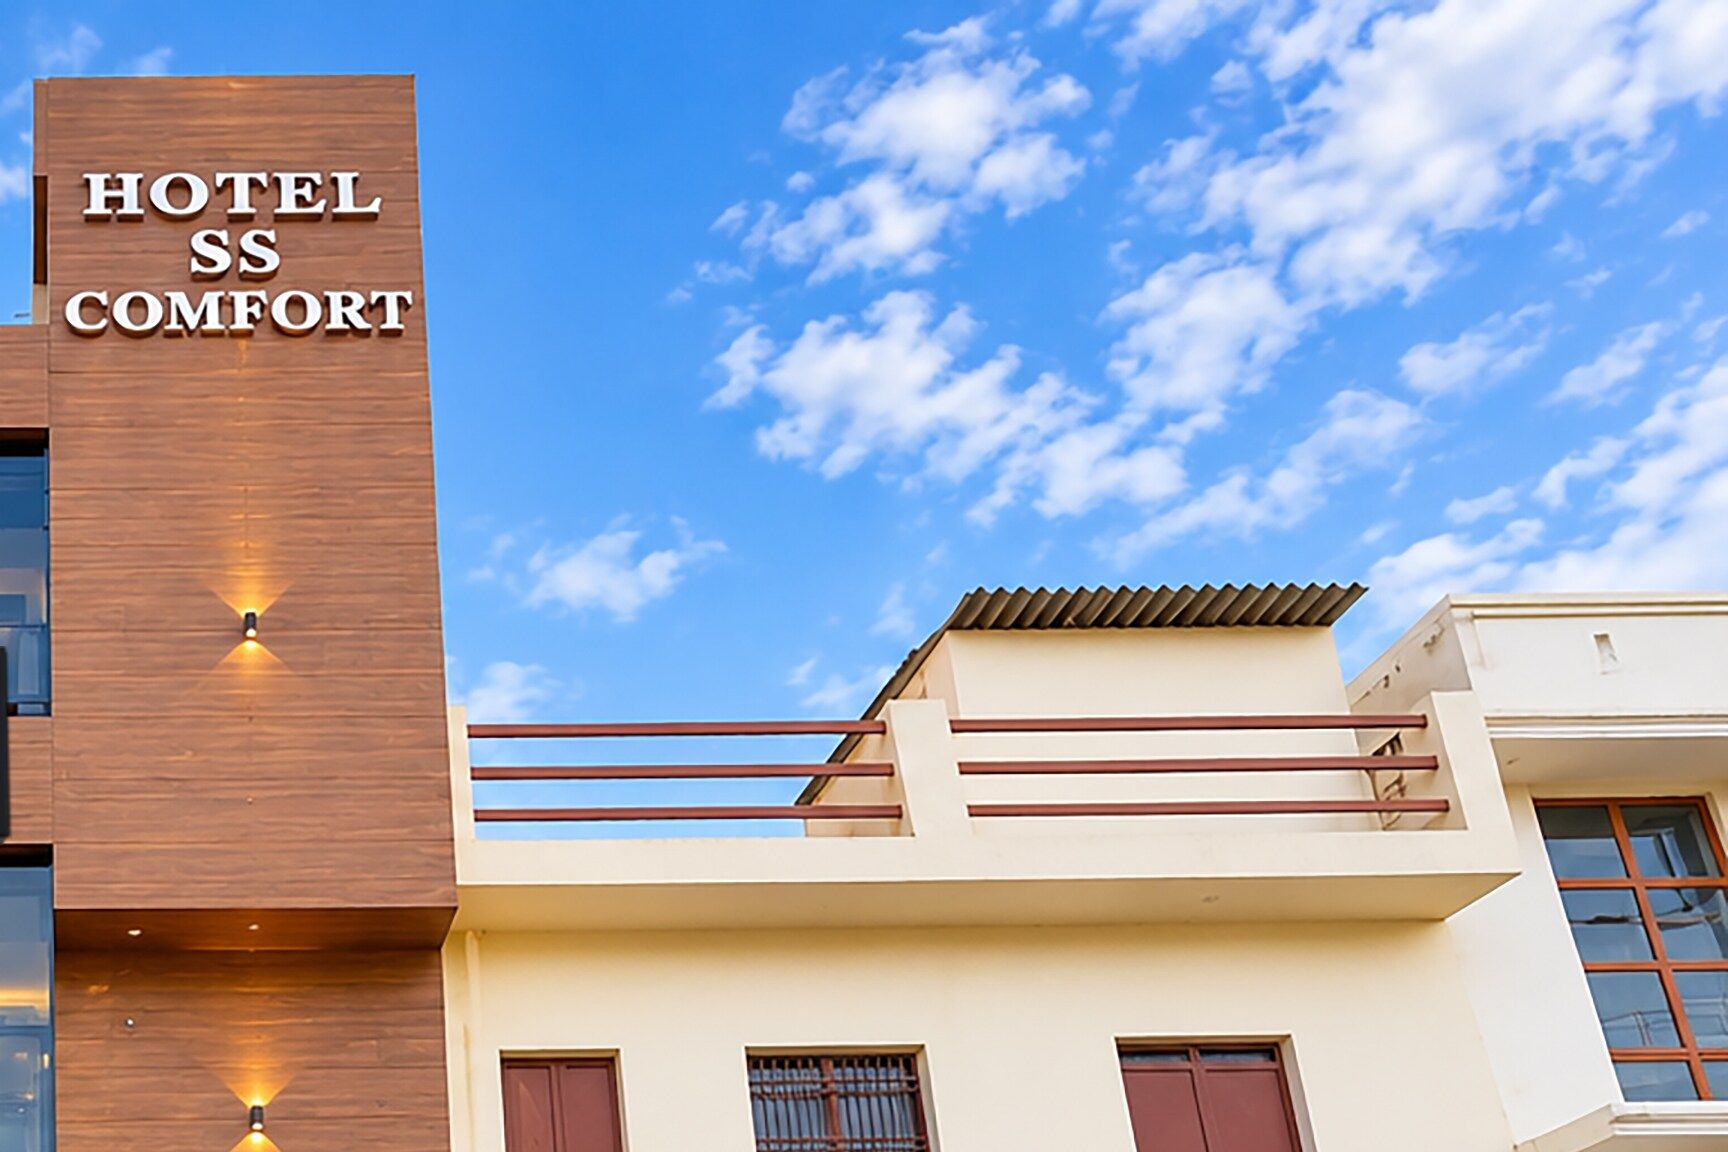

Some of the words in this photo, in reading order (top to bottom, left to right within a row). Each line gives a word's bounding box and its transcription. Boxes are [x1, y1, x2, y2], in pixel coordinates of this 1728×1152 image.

[82, 171, 382, 215] HOTEL
[190, 229, 280, 273] SS
[65, 289, 413, 331] COMFORT
